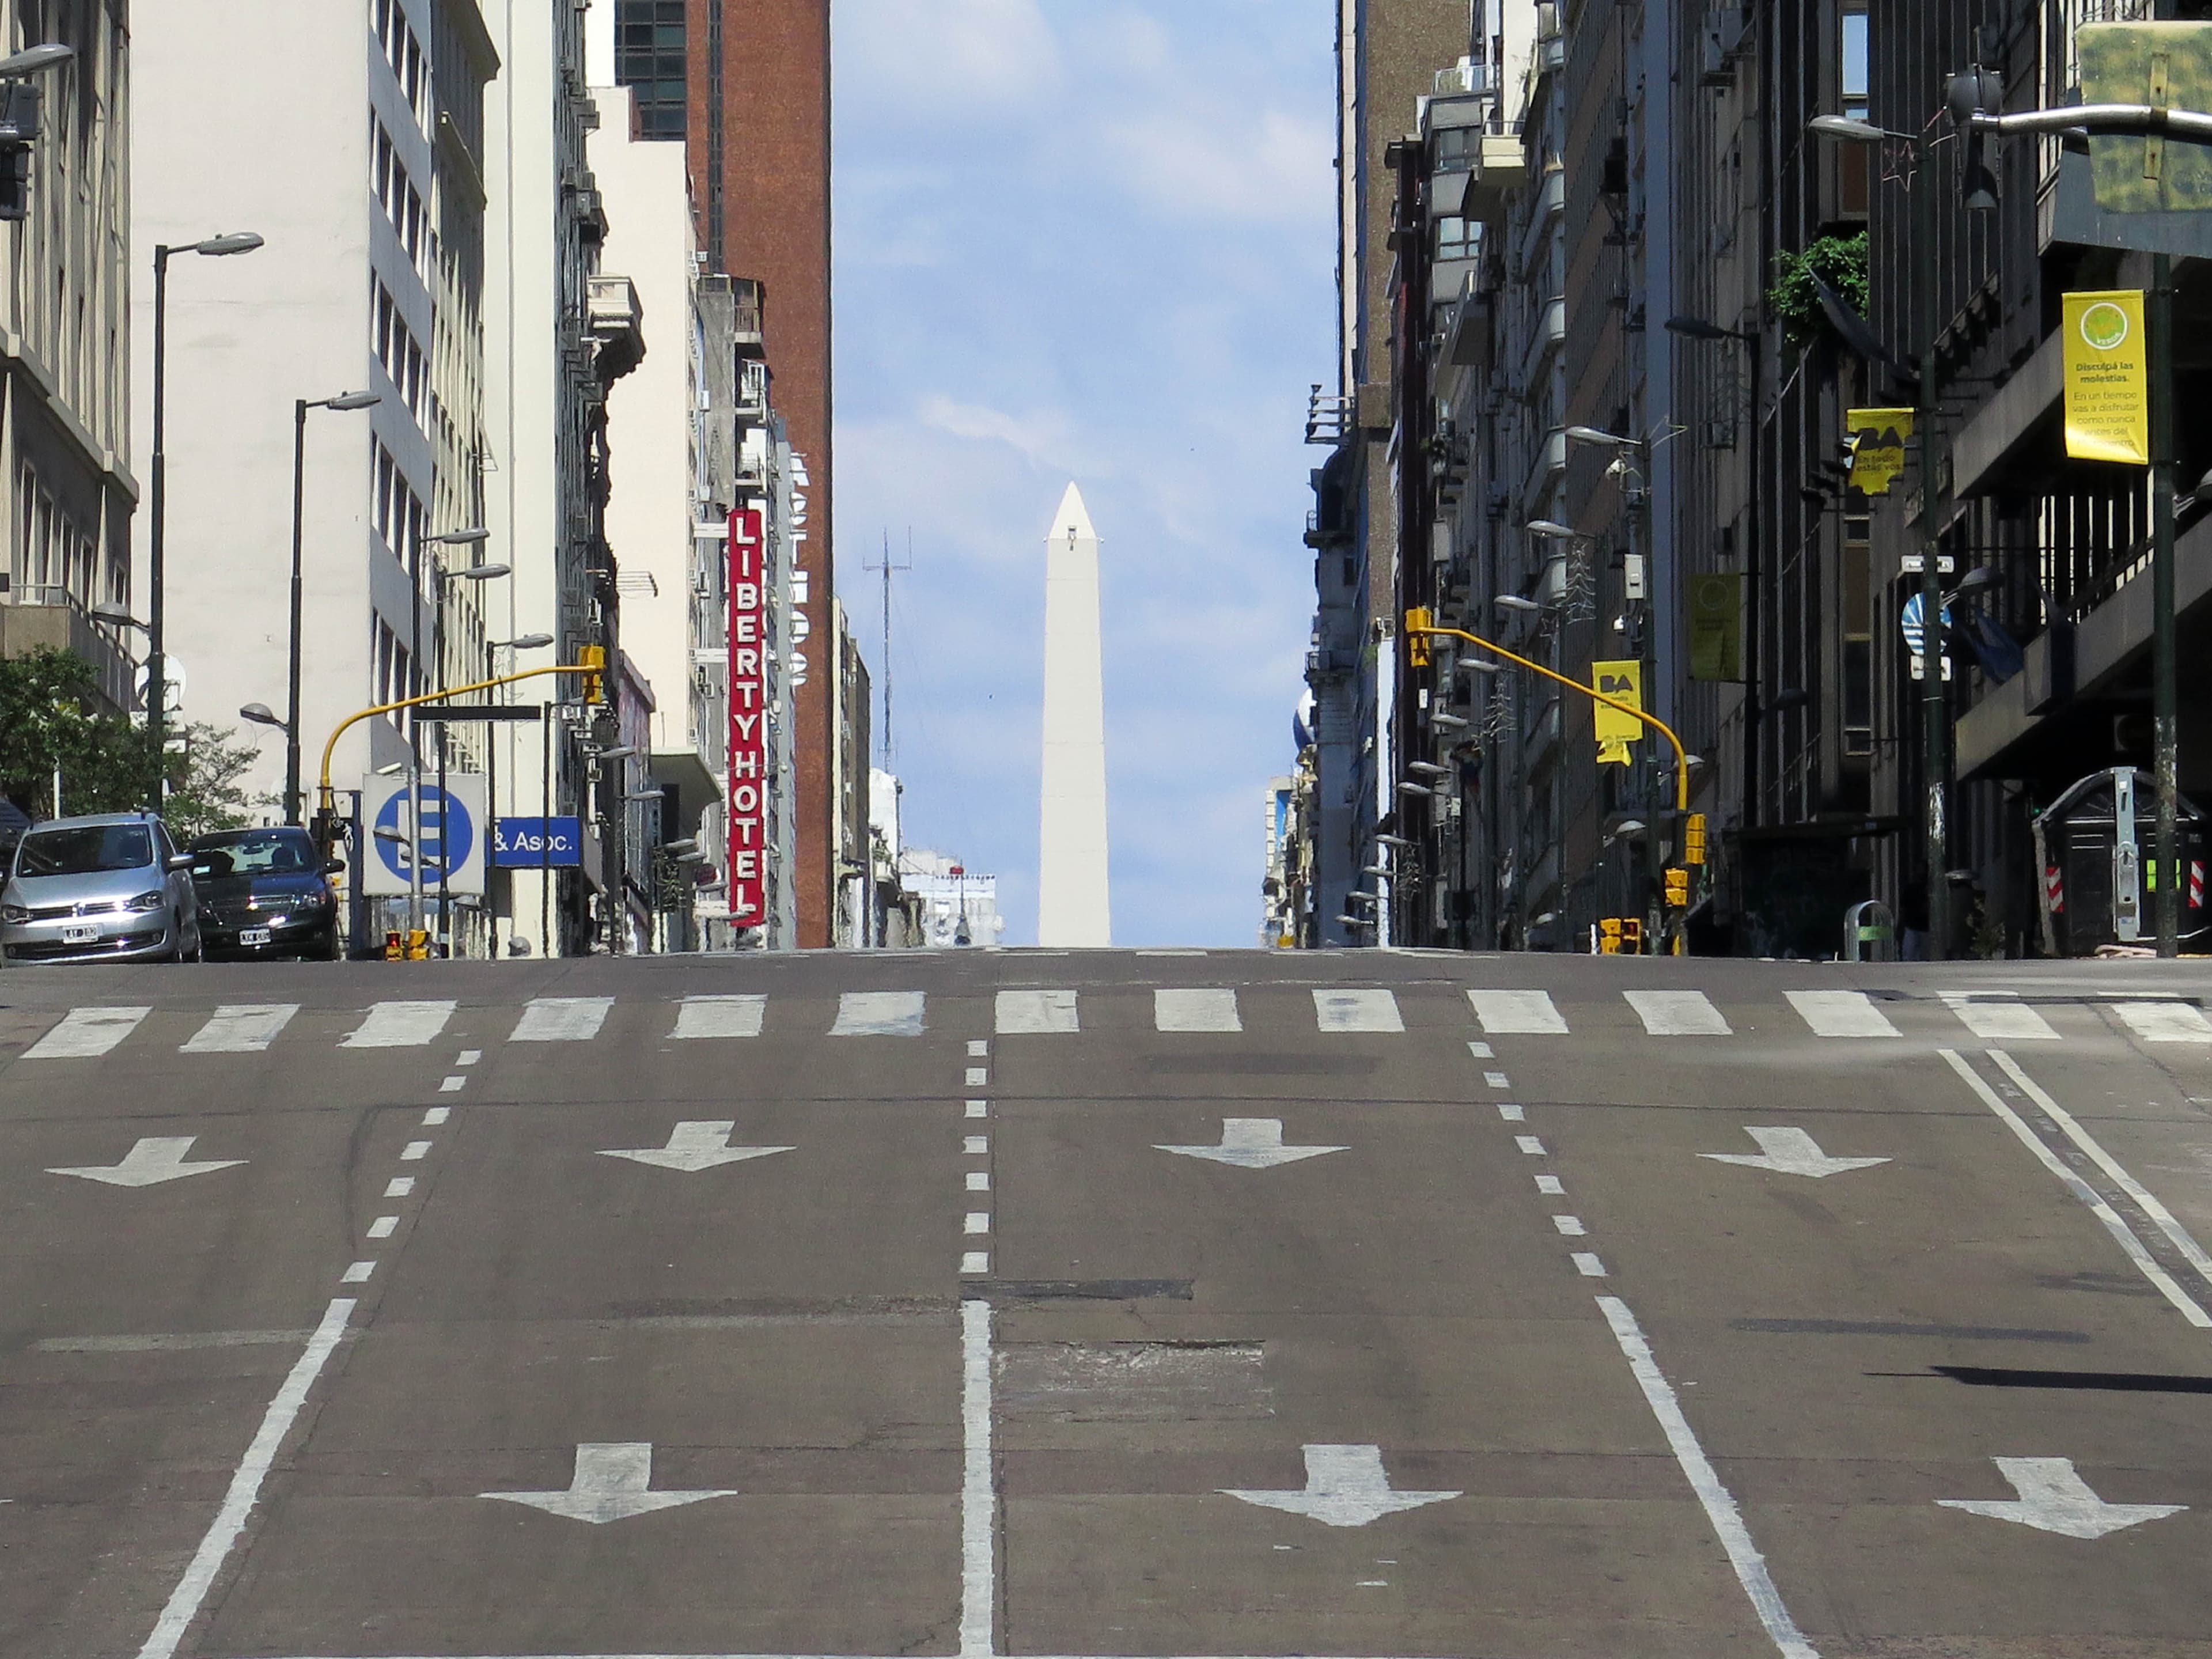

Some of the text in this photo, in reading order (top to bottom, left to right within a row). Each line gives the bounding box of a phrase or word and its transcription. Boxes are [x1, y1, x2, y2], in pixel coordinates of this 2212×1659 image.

[2075, 361, 2134, 372] Disculpá las
[2080, 374, 2130, 383] molestias.
[2074, 392, 2086, 400] En
[2103, 391, 2137, 400] tiempo
[2099, 403, 2139, 411] disfrutar
[2107, 415, 2135, 424] nunca
[733, 517, 759, 915] LIBERTY HOTEL
[397, 800, 449, 869] E
[513, 831, 573, 852] Asoc.
